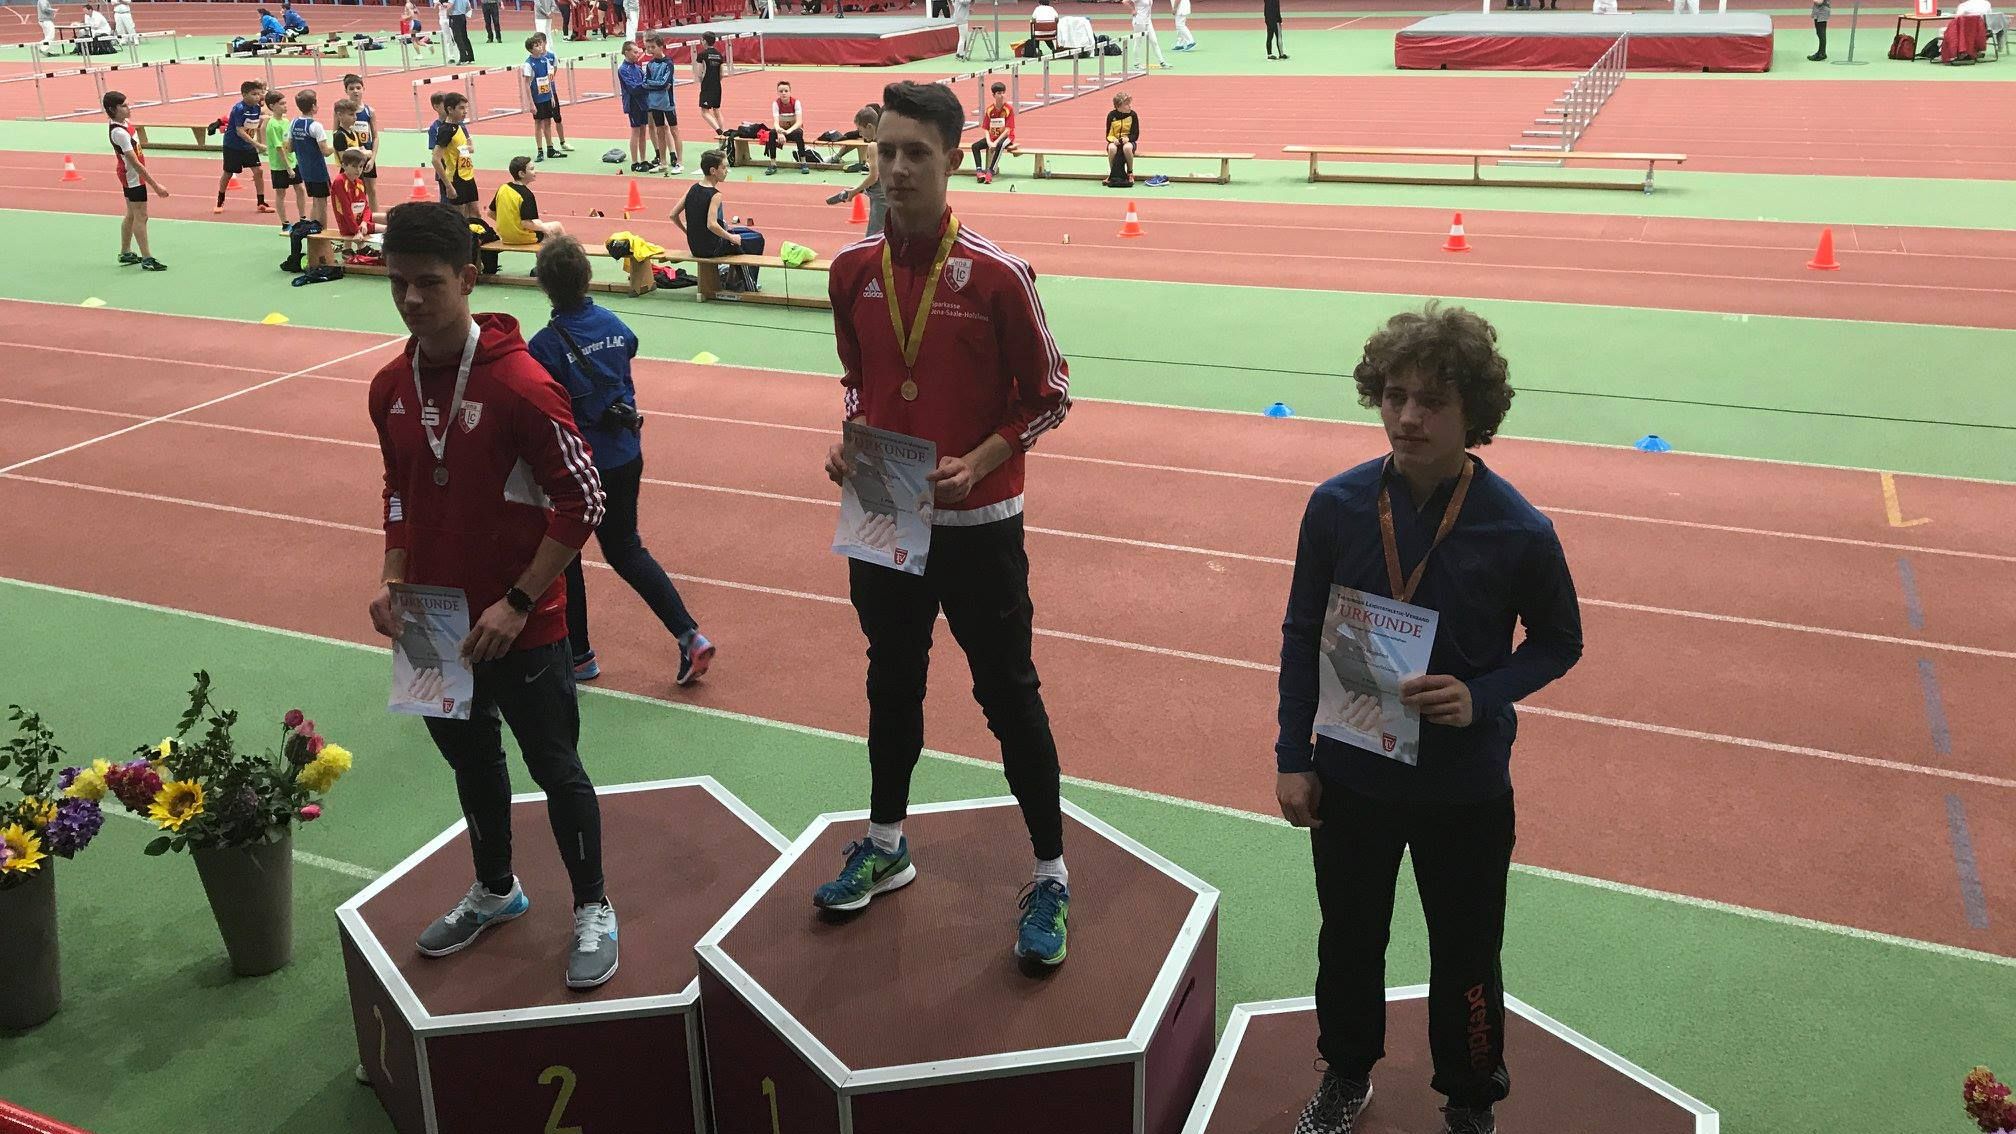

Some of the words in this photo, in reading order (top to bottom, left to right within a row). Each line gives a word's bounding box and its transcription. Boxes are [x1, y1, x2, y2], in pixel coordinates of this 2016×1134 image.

[931, 301, 961, 309] Sparkasse
[606, 336, 625, 348] LAC
[1340, 604, 1423, 638] URKUNDE
[537, 1064, 583, 1134] 2
[761, 1076, 780, 1134] 1
